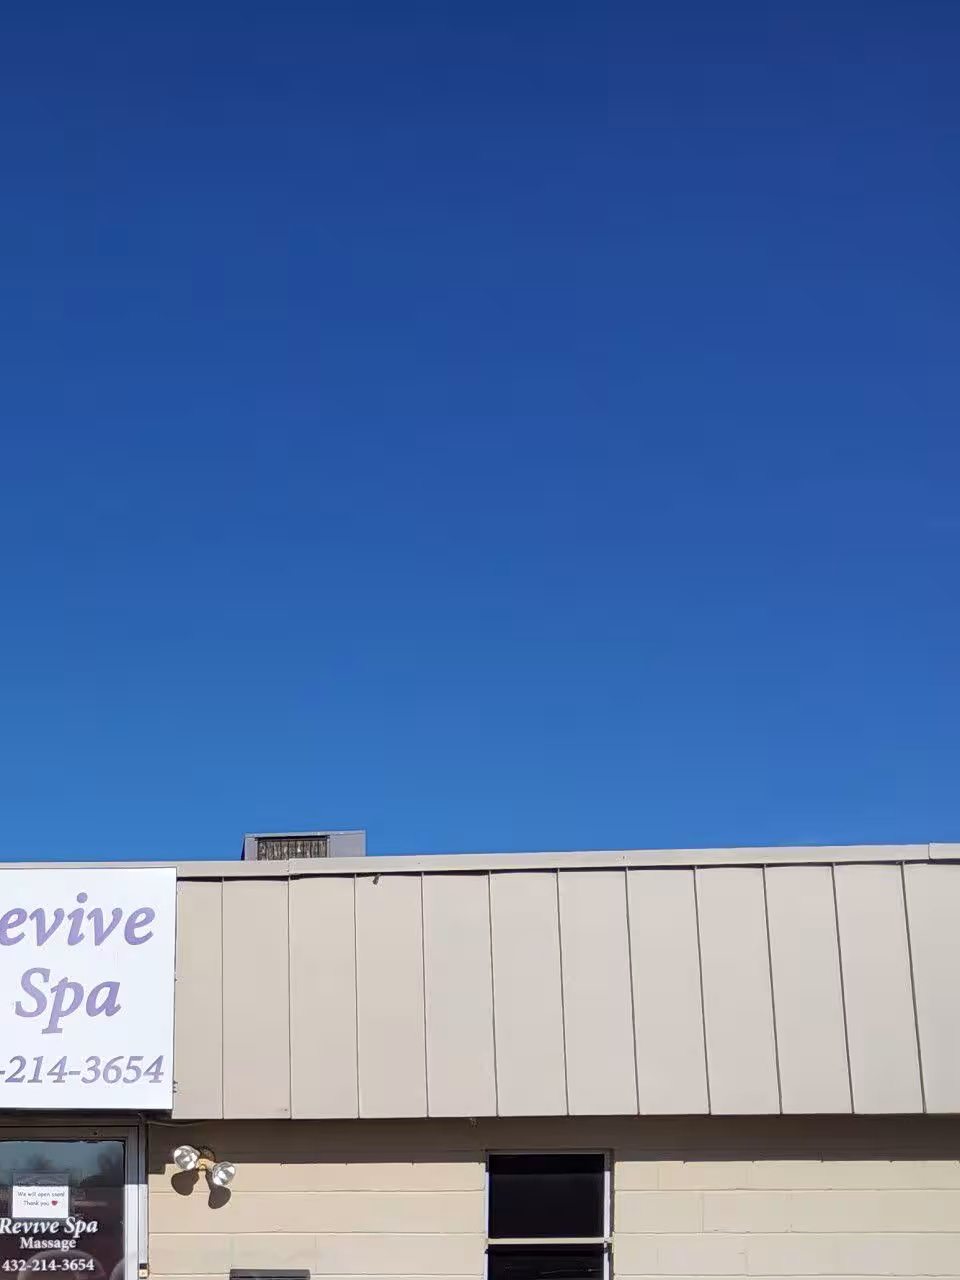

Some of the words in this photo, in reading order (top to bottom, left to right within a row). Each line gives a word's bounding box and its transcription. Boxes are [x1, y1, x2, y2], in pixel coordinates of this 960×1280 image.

[14, 966, 122, 1035] Spa
[64, 1216, 98, 1238] Spa
[20, 1236, 77, 1252] Massage
[2, 1258, 95, 1271] 432-214-3654
